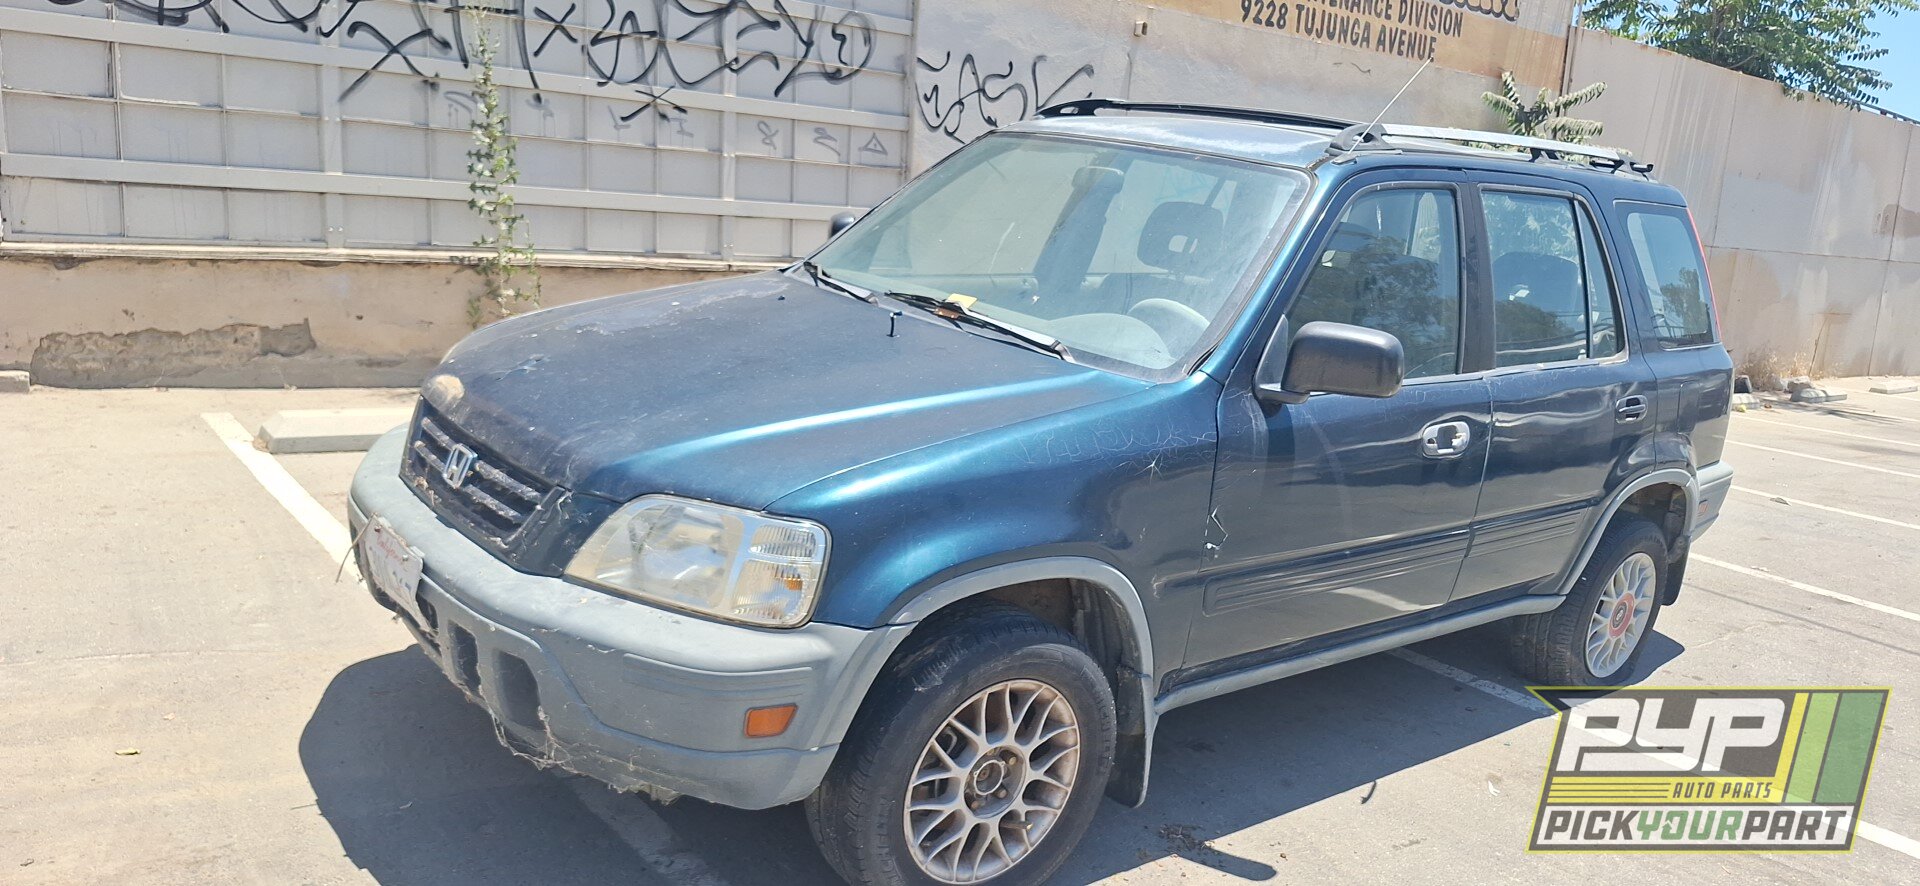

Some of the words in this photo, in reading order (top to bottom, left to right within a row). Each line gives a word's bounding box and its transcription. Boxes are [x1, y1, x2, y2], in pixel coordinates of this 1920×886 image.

[1241, 0, 1288, 29] 9228
[1295, 4, 1371, 49] TUJUNGA
[1376, 24, 1437, 62] AVENUE
[1398, 0, 1463, 38] DIVISION
